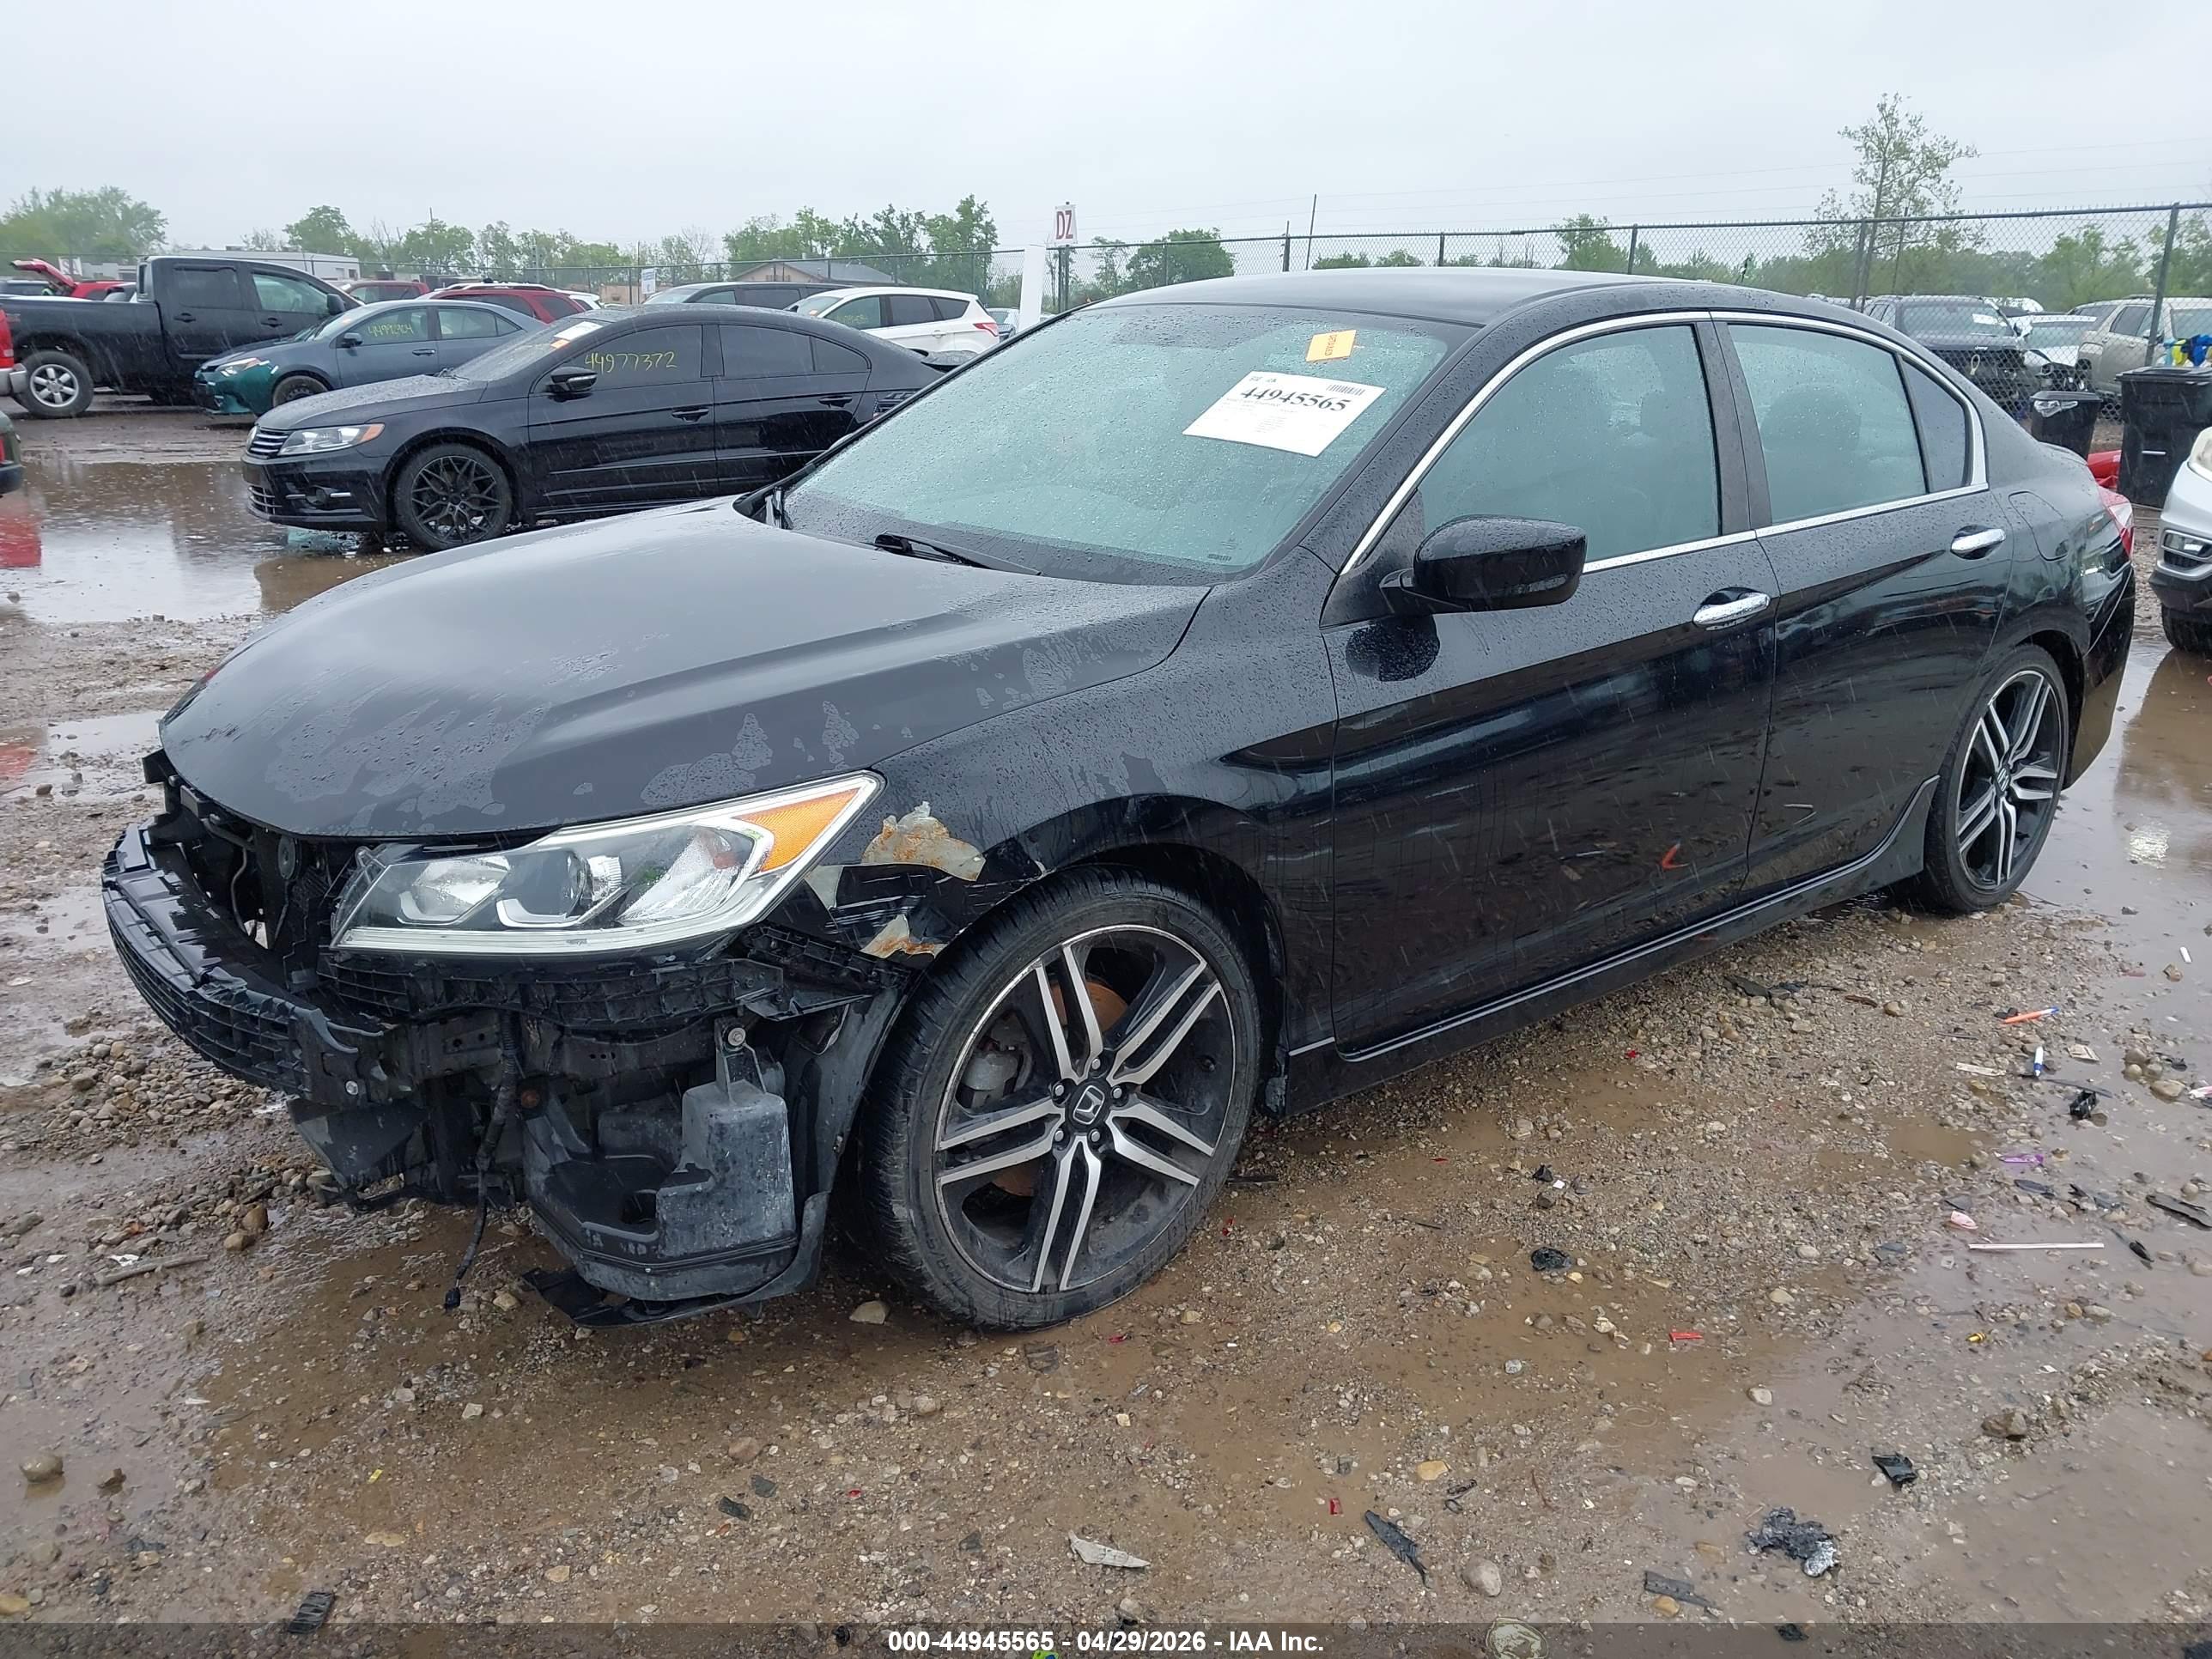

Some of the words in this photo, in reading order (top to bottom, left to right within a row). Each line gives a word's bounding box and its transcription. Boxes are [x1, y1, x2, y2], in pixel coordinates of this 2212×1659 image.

[1056, 210, 1074, 240] DZ
[584, 351, 678, 374] 44977372
[1241, 387, 1352, 411] 44945565
